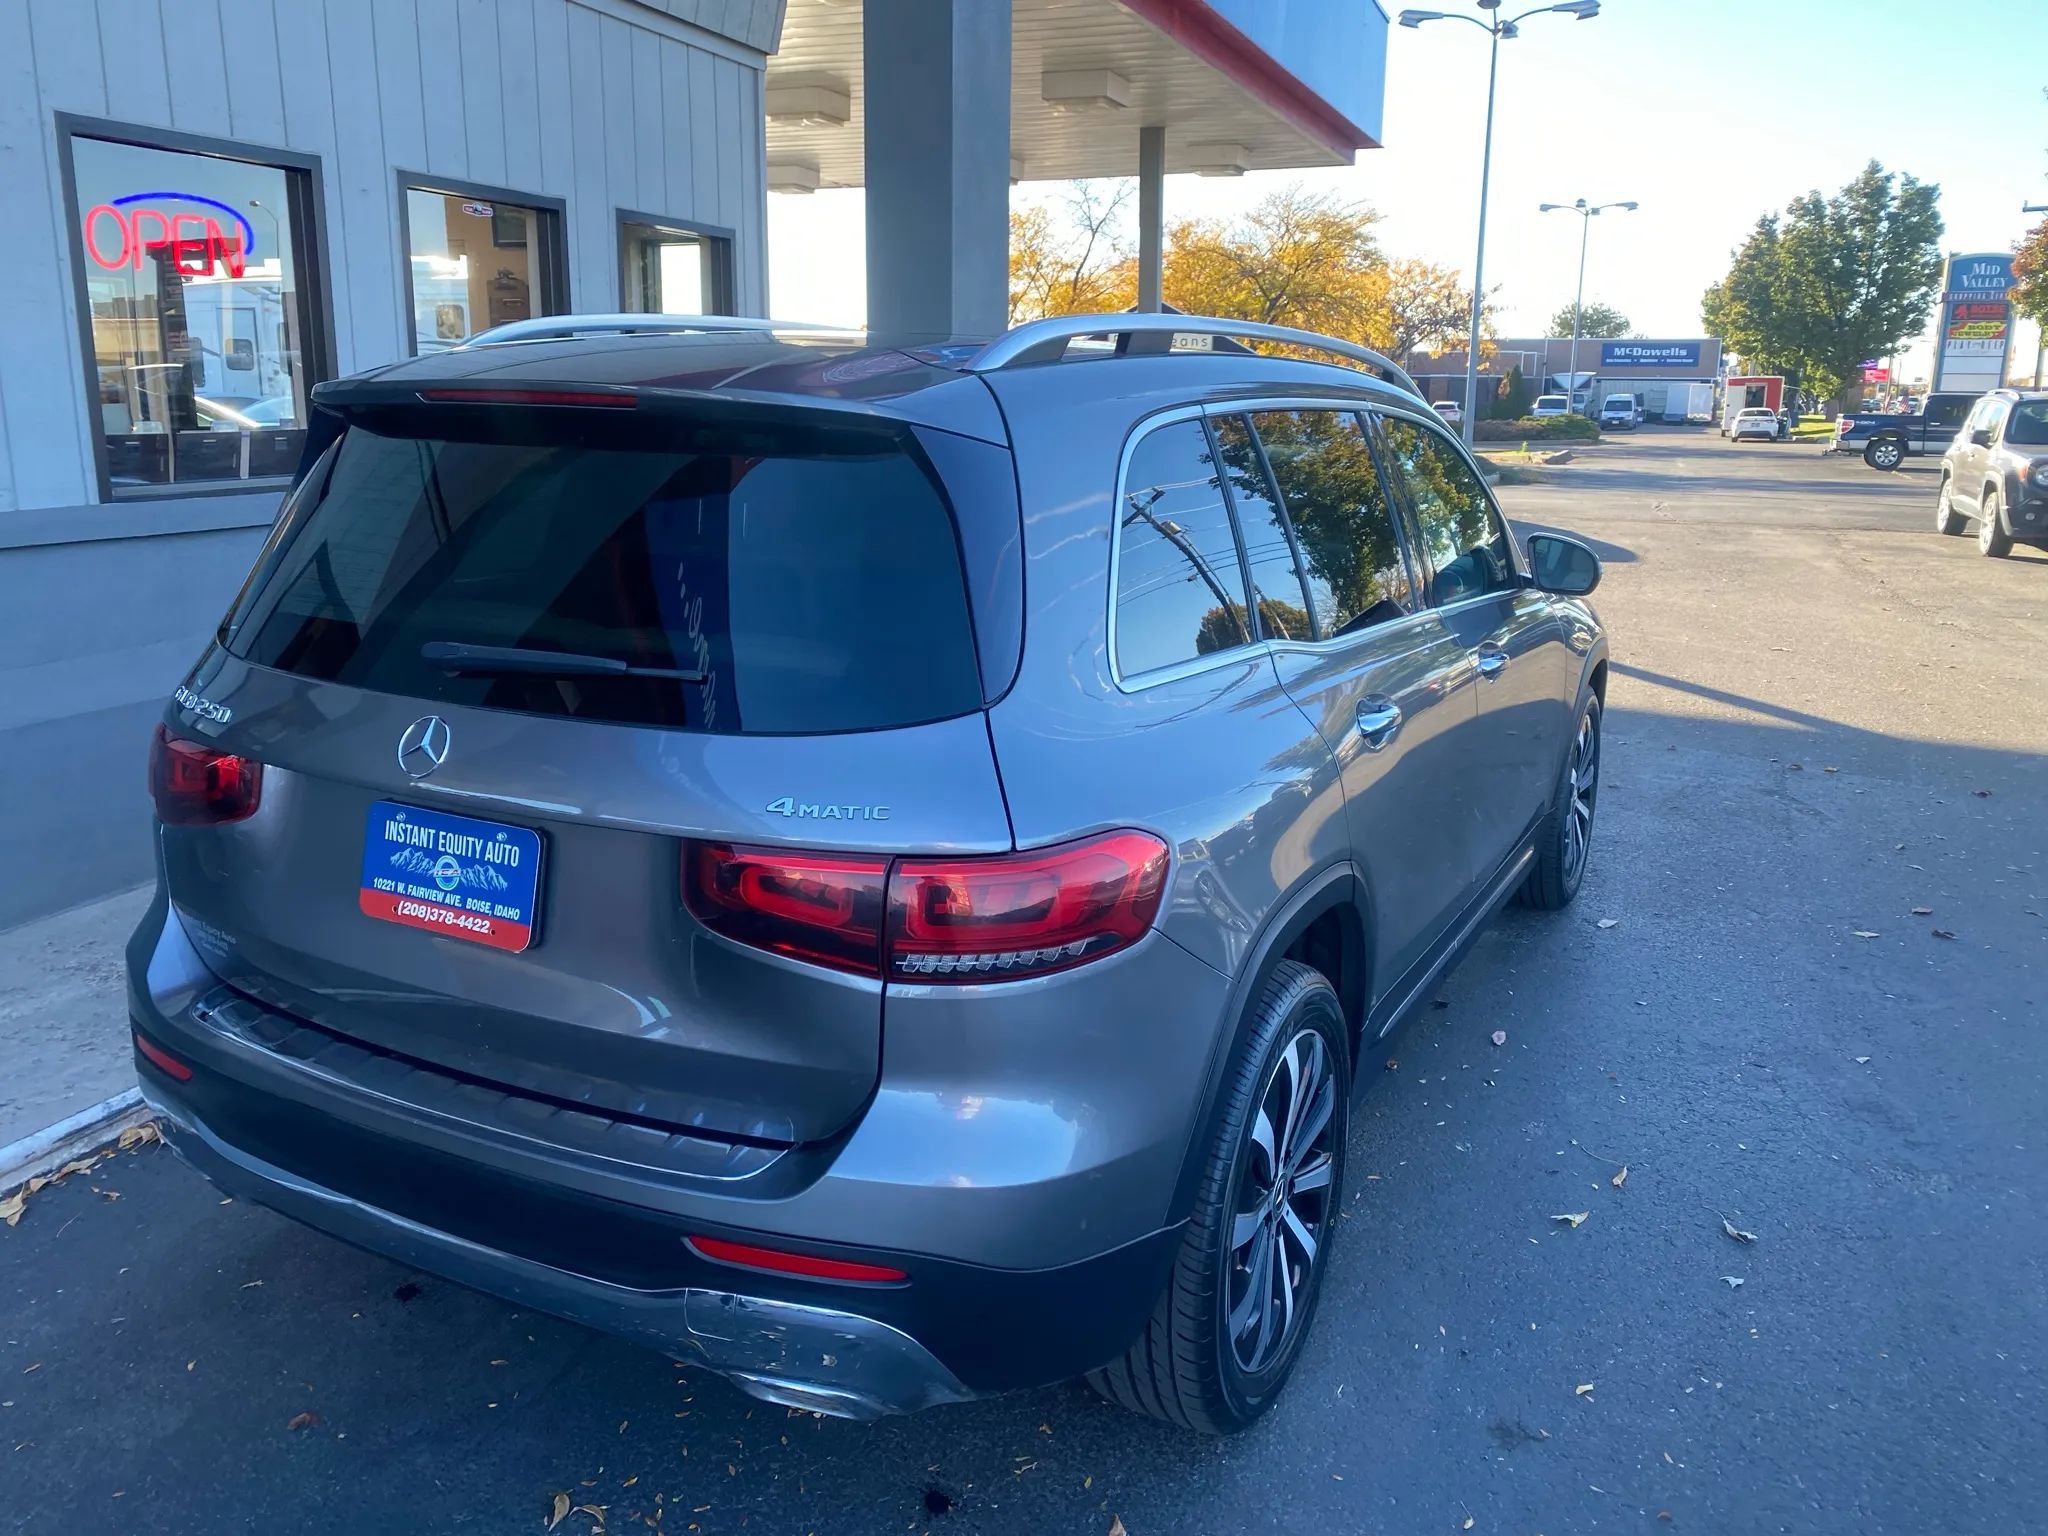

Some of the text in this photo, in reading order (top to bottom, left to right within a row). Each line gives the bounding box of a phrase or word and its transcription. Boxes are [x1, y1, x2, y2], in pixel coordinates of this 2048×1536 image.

[84, 204, 246, 279] OPEN
[1961, 275, 2008, 288] VALLEY
[1972, 262, 2001, 275] MID
[1613, 347, 1688, 356] McDowells
[766, 797, 890, 820] 4MATIC
[384, 819, 520, 867] INSTANT EQUITY AUTO
[373, 876, 520, 920] 10221 W. FAIRVIEW AVE. BOISE, IDAHO
[397, 900, 490, 934] (208)378-4422
